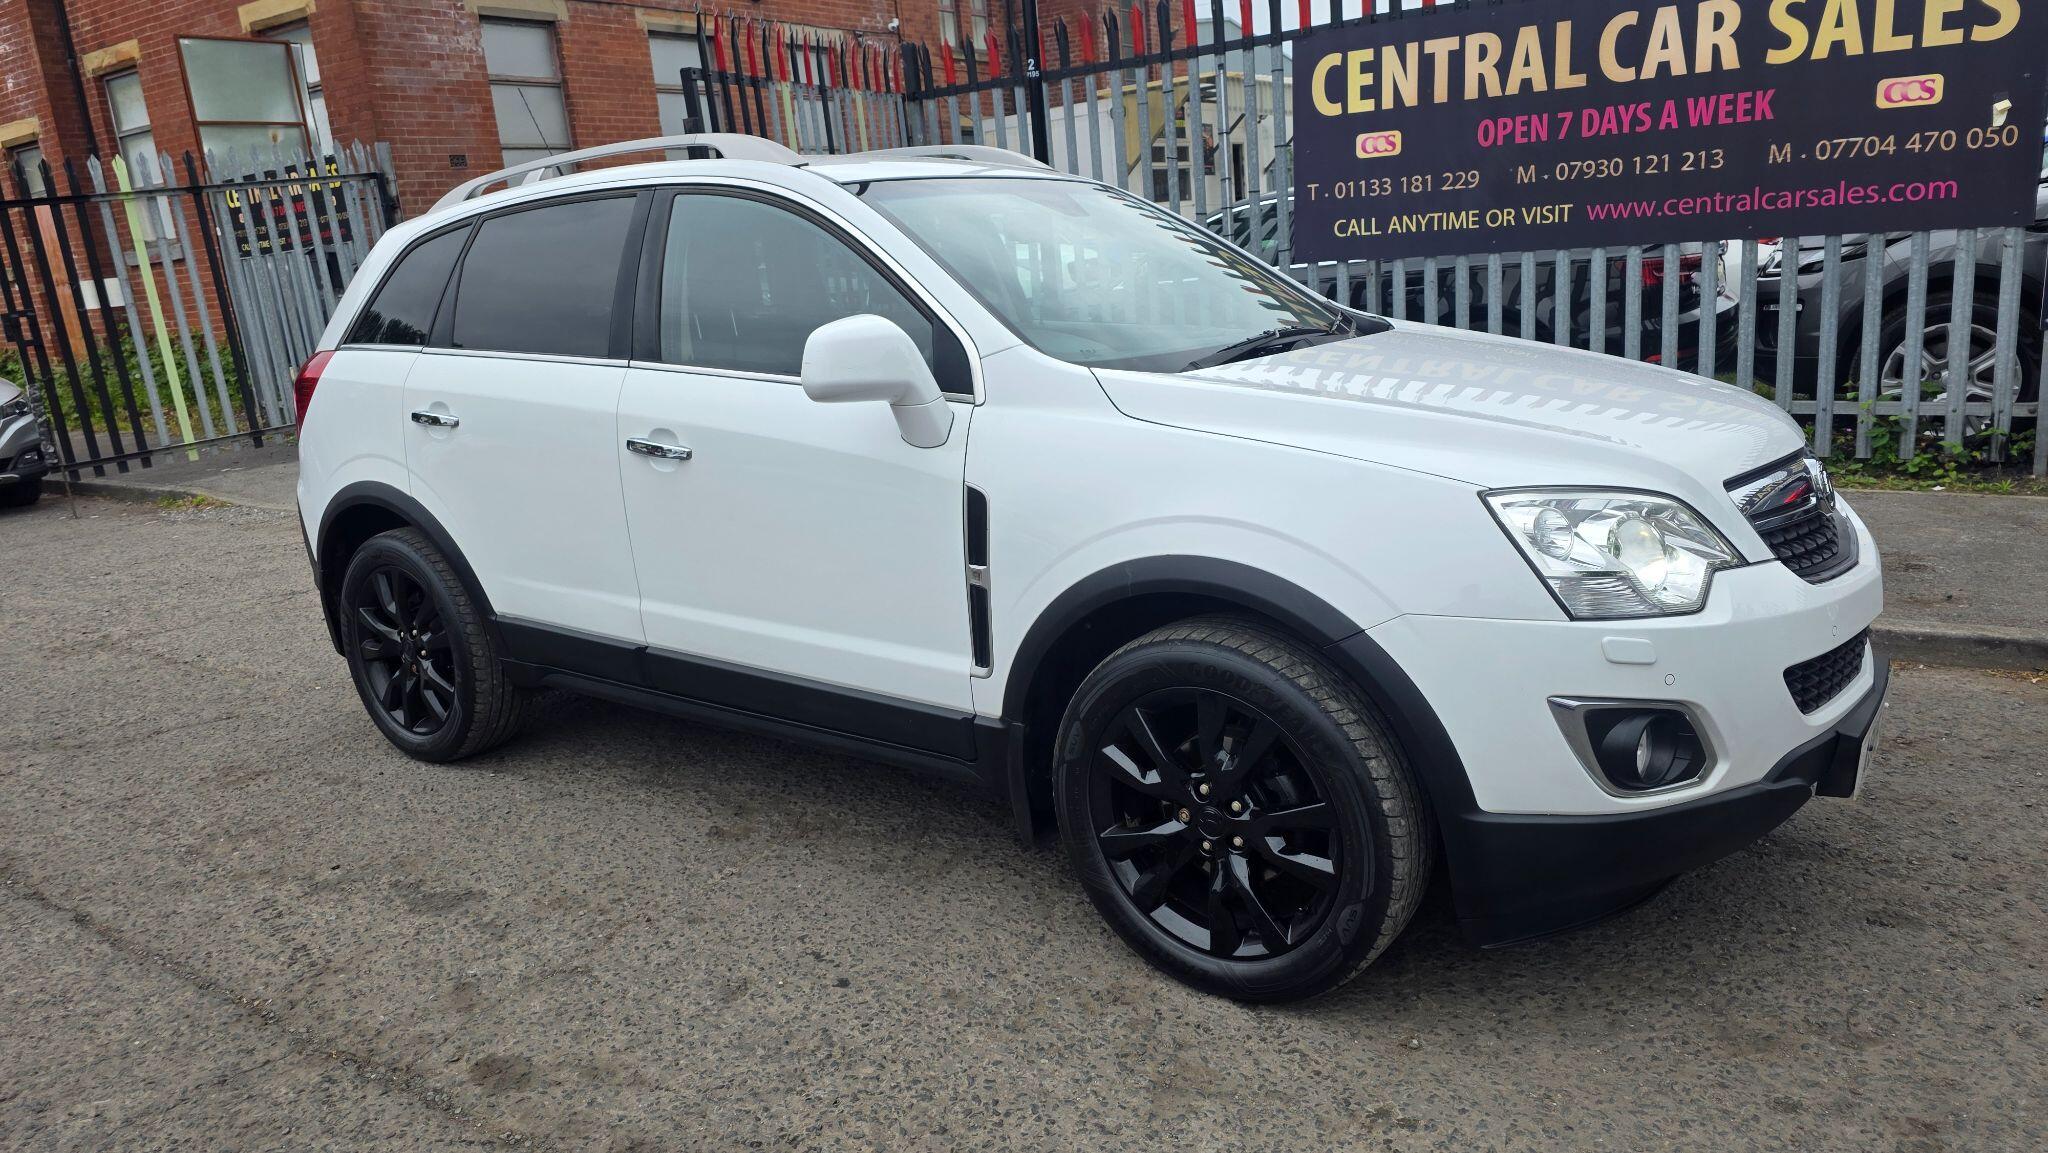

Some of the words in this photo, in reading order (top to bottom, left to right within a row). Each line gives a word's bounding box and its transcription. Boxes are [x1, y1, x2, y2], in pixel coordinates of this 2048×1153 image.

[1028, 58, 1035, 70] 2
[1312, 21, 1587, 117] CENTRAL
[1599, 0, 1742, 82] CAR
[1766, 0, 2021, 64] SALES
[1477, 113, 1548, 148] OPEN
[1557, 111, 1573, 140] 7
[1581, 102, 1651, 138] DAYS
[1659, 100, 1679, 130] A
[1687, 88, 1776, 127] WEEK
[1883, 78, 1936, 103] CCS
[1307, 183, 1320, 200] T
[1334, 178, 1392, 199] 01133
[1400, 174, 1432, 194] 181
[1441, 170, 1480, 191] 229
[1516, 164, 1536, 184] M
[1555, 157, 1624, 181] 07930
[1632, 154, 1670, 175] 121
[1680, 149, 1725, 171] 213
[1768, 142, 1792, 164] M
[1815, 134, 1896, 161] 07704
[1905, 129, 1957, 153] 470
[1966, 124, 2019, 149] 050
[1360, 134, 1397, 155] CCS
[1334, 217, 1382, 238] CALL
[1387, 209, 1480, 235] ANYTIME
[1485, 208, 1516, 228] OR
[1521, 203, 1574, 226] VISIT
[1586, 179, 1958, 222] www.centralcarsales.com
